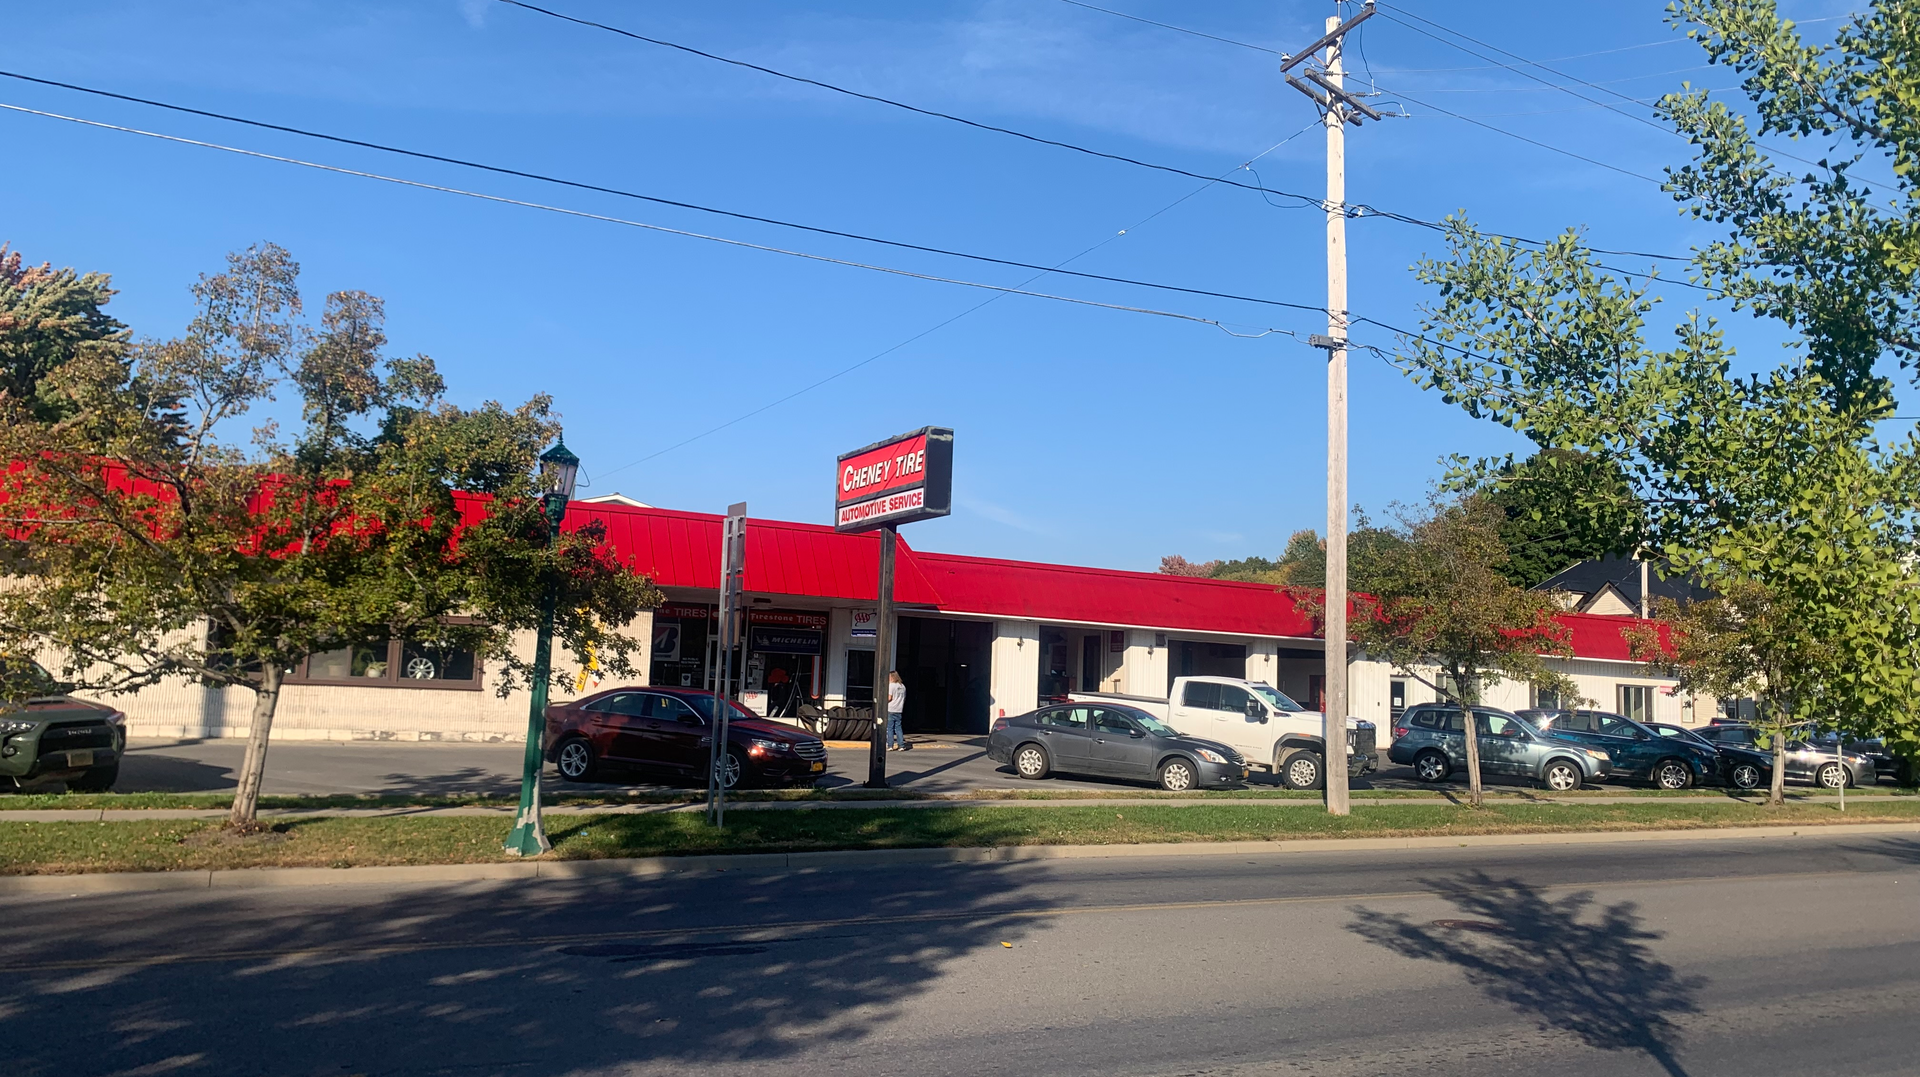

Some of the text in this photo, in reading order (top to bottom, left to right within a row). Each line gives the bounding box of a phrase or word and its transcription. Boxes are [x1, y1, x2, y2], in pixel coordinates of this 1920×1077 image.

[843, 449, 925, 492] CHENEY TIRE
[841, 492, 922, 522] AUTOMOTIVE SERVICE
[673, 607, 708, 618] TIRES
[750, 613, 827, 625] Firestone TIRES
[771, 636, 819, 645] MICHELIN
